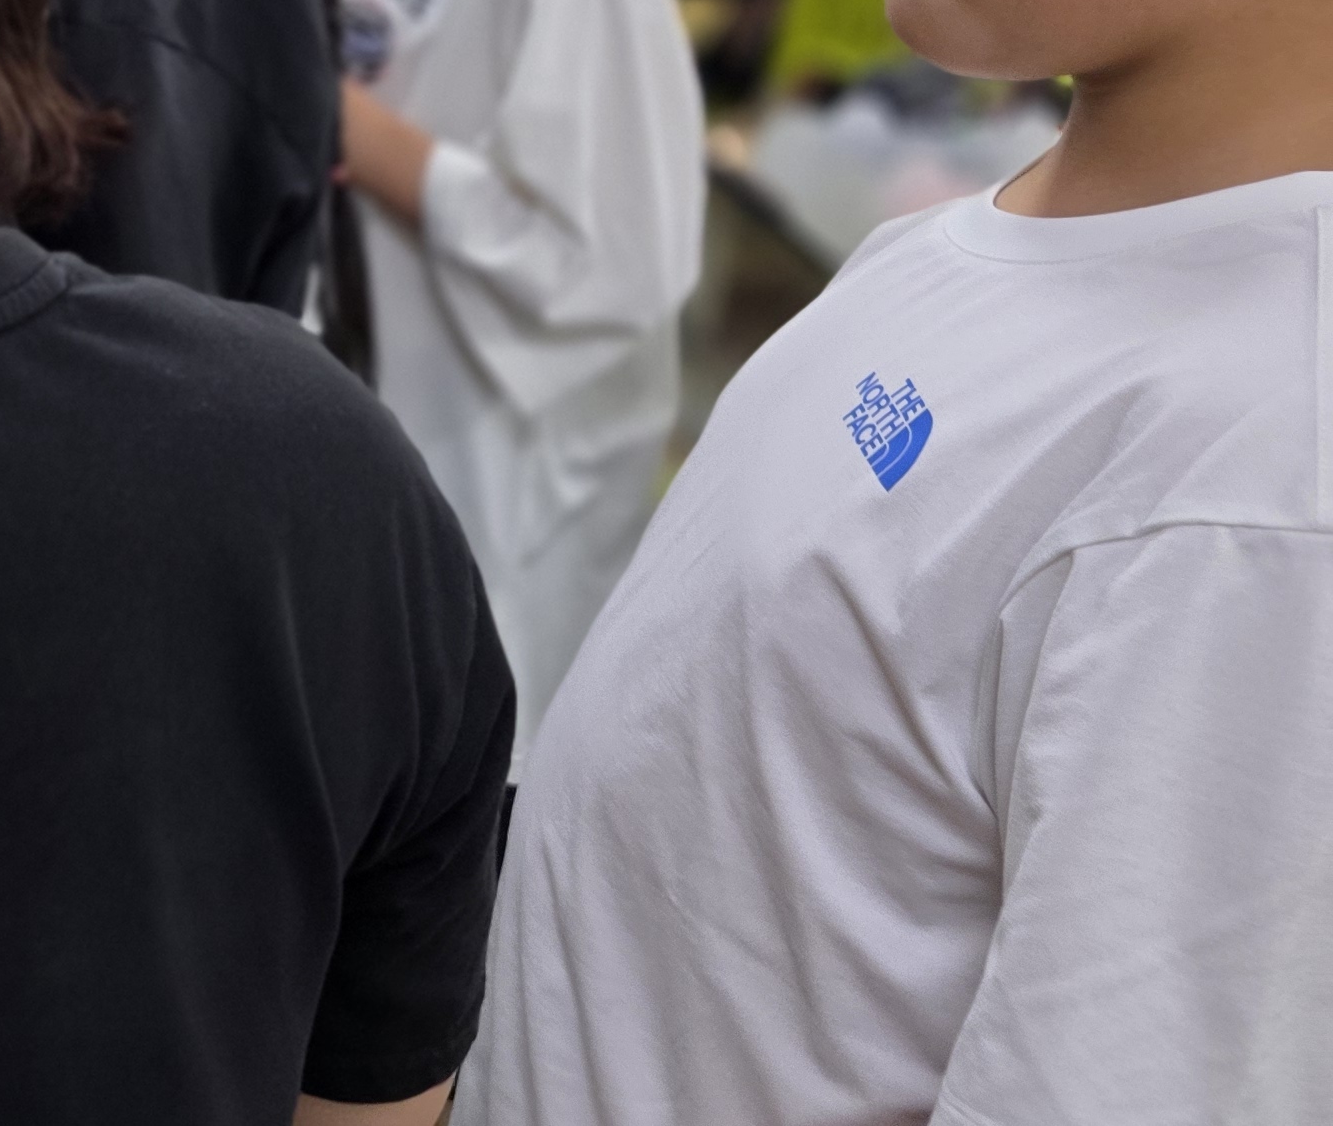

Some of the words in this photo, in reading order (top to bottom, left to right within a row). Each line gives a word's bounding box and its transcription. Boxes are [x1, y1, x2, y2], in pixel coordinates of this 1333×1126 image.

[855, 371, 905, 440] NORTH
[891, 378, 926, 422] THE
[841, 402, 884, 458] FACE
